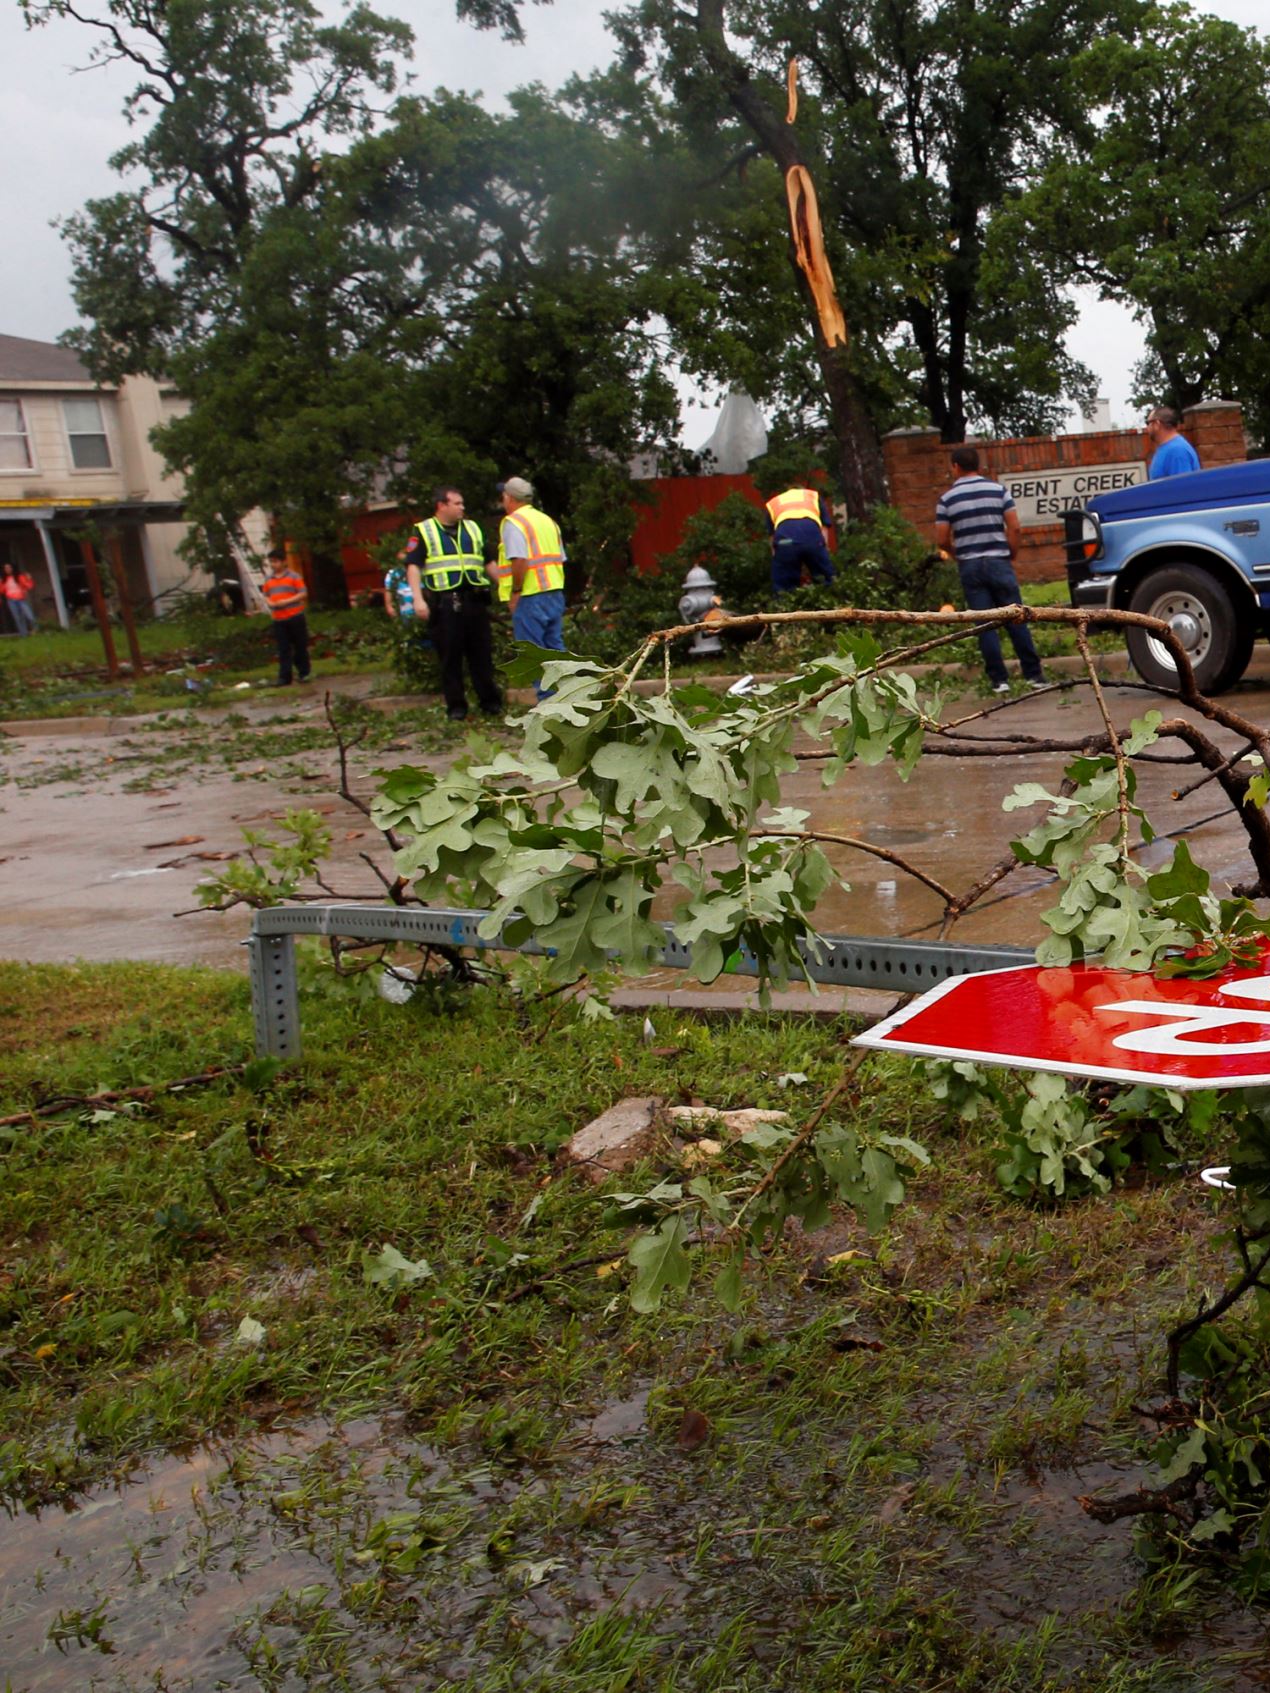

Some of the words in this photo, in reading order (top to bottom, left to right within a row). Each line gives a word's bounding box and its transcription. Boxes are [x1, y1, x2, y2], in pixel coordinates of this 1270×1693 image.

[1011, 480, 1061, 498] BENT
[1074, 472, 1135, 492] CREEK
[1036, 494, 1104, 514] ESTAT
